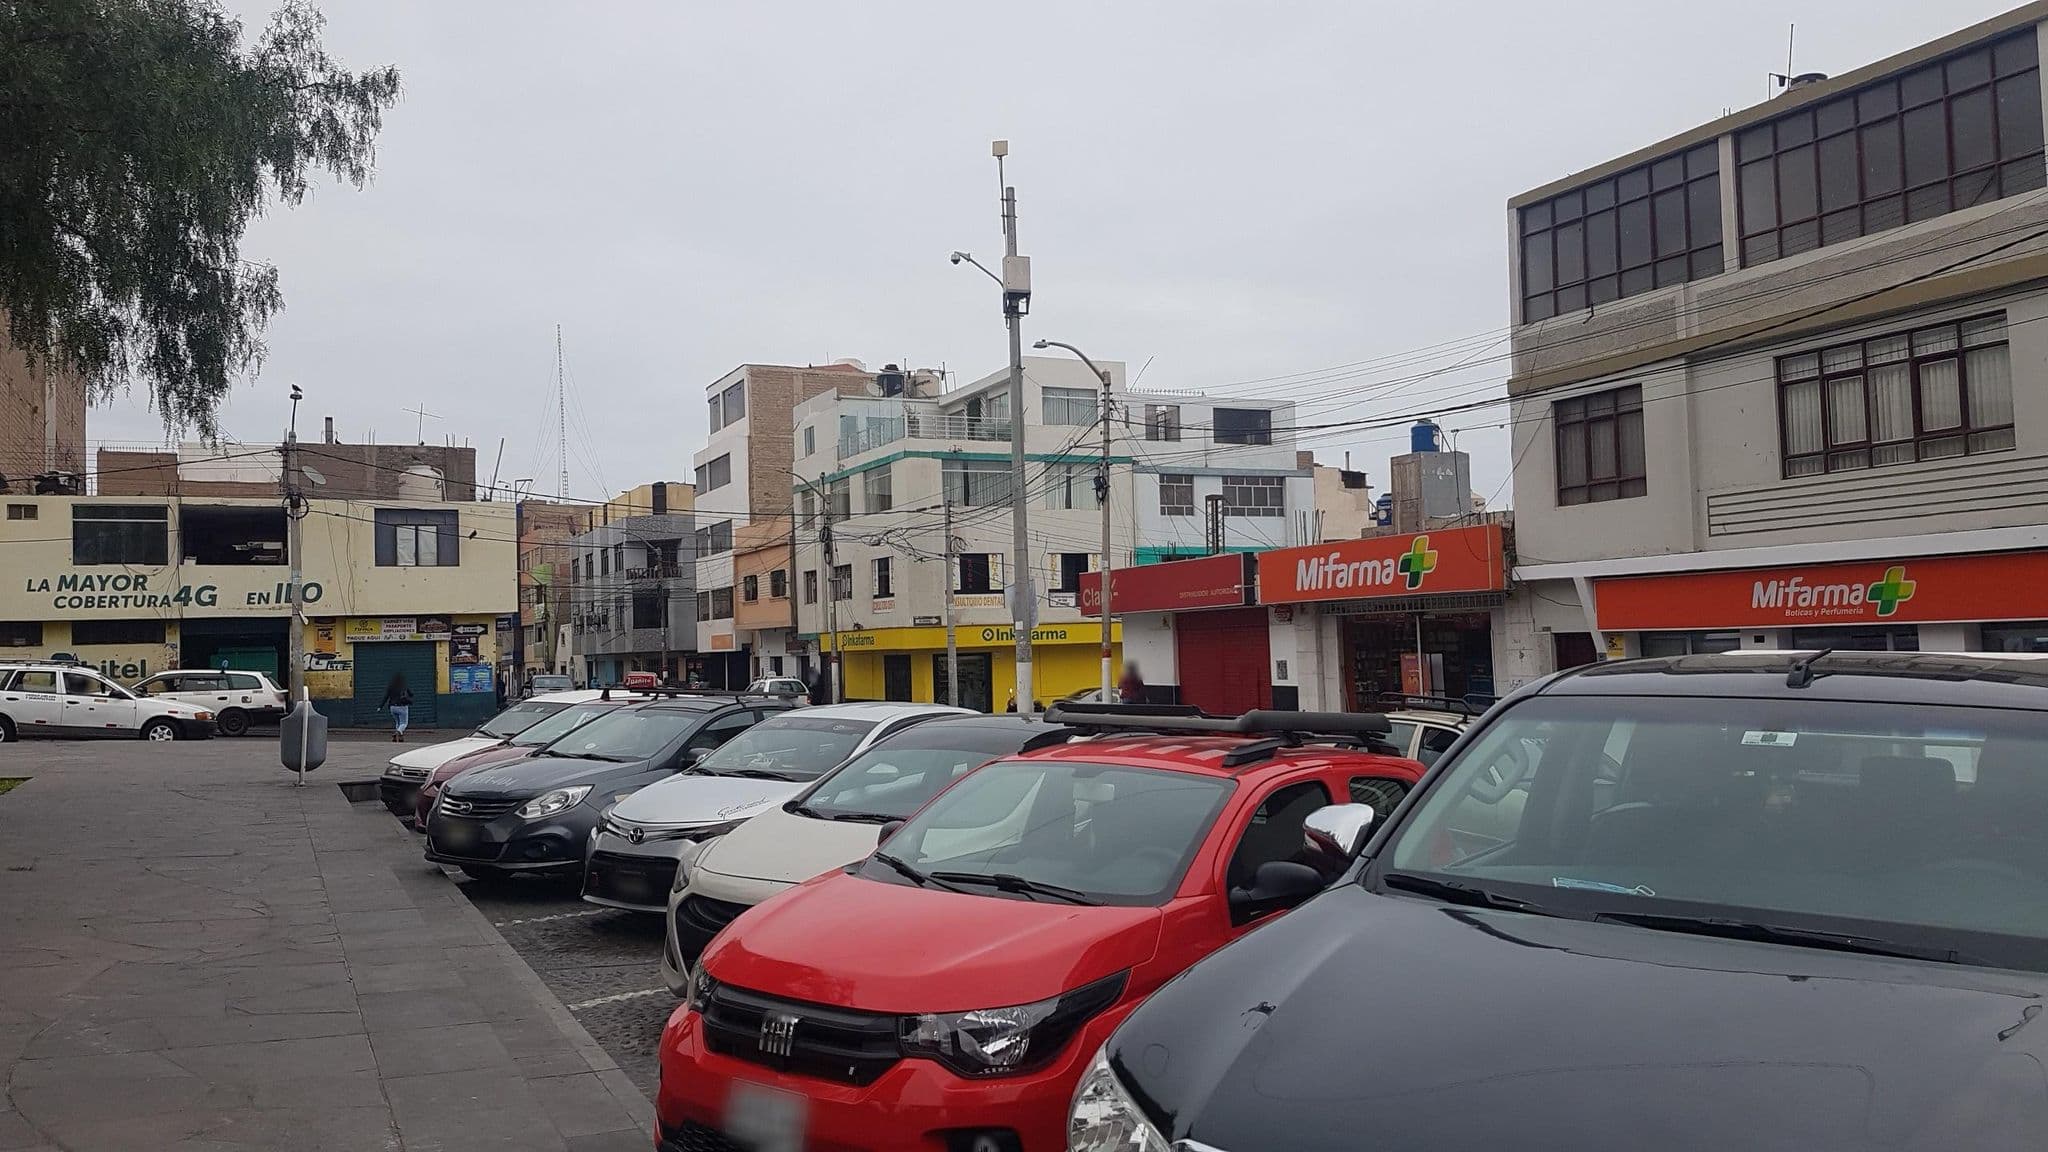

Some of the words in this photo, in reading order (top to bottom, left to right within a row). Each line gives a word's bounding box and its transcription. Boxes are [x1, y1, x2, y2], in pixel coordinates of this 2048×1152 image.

[1295, 552, 1395, 592] Mifarma
[27, 579, 50, 592] LA
[57, 574, 148, 592] MAYOR
[54, 595, 172, 609] COBERTURA
[173, 585, 218, 607] 4G
[246, 592, 270, 605] EN
[275, 582, 323, 604] ILO
[1752, 576, 1865, 609] Mifarma
[1785, 609, 1813, 617] Boticas
[847, 634, 875, 646] Inkafarma
[996, 629, 1067, 641] Inkarma
